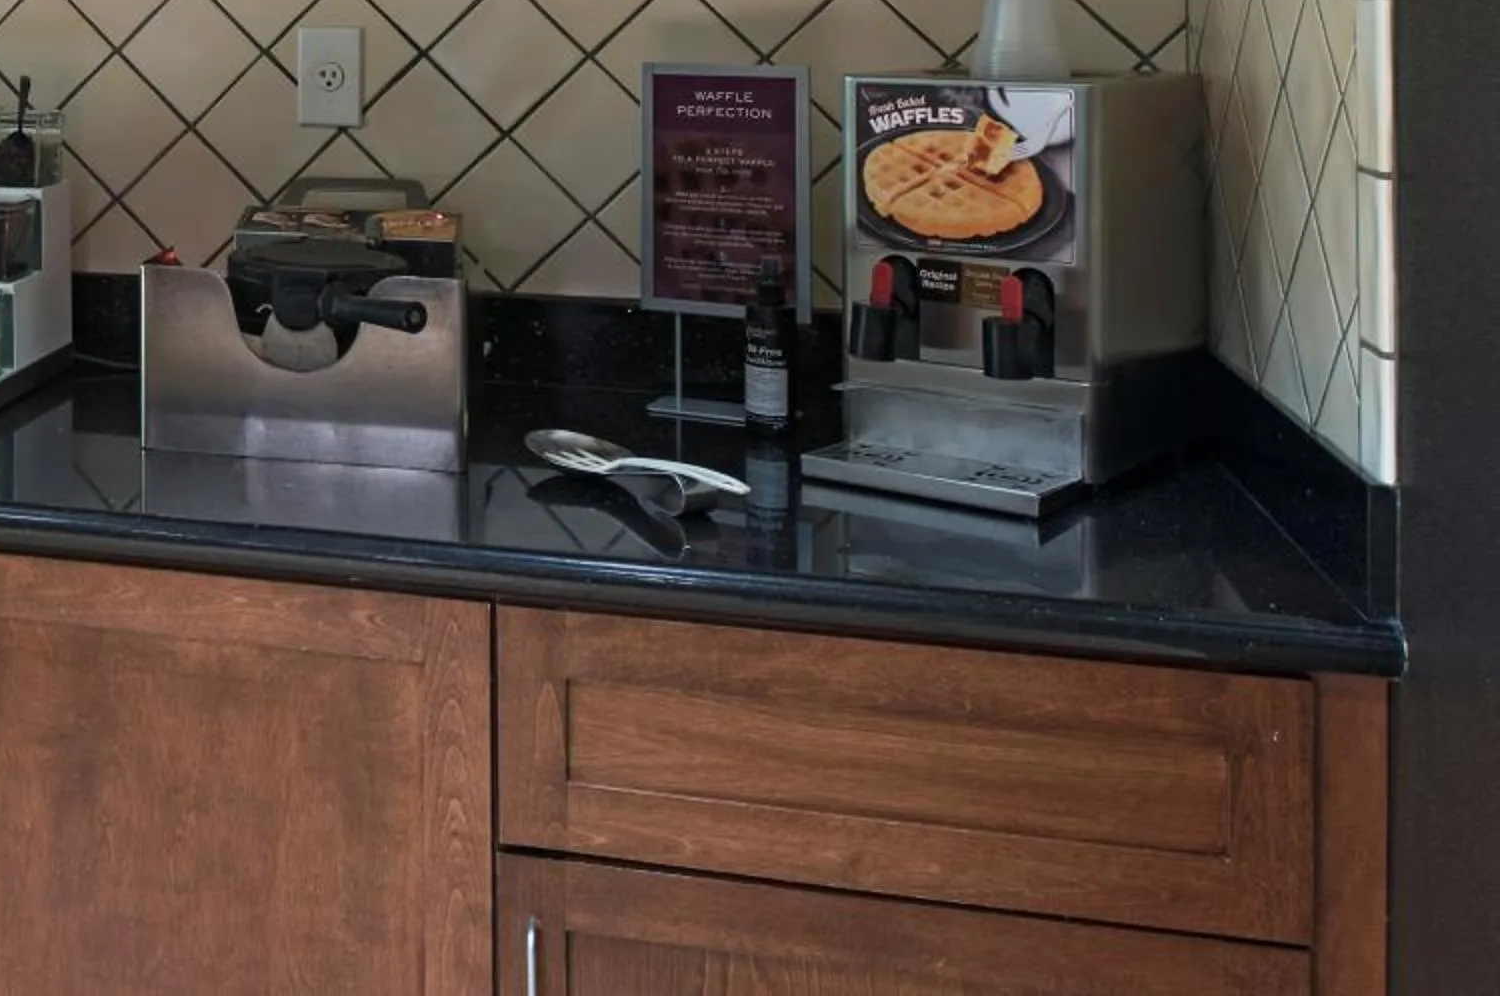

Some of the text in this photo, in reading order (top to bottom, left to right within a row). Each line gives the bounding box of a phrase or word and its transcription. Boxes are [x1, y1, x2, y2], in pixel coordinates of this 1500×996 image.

[694, 91, 755, 103] WAFFLE
[676, 105, 774, 120] PERFECTION
[868, 107, 965, 134] WAFFLES
[919, 268, 958, 282] Original
[921, 279, 956, 291] Recipe
